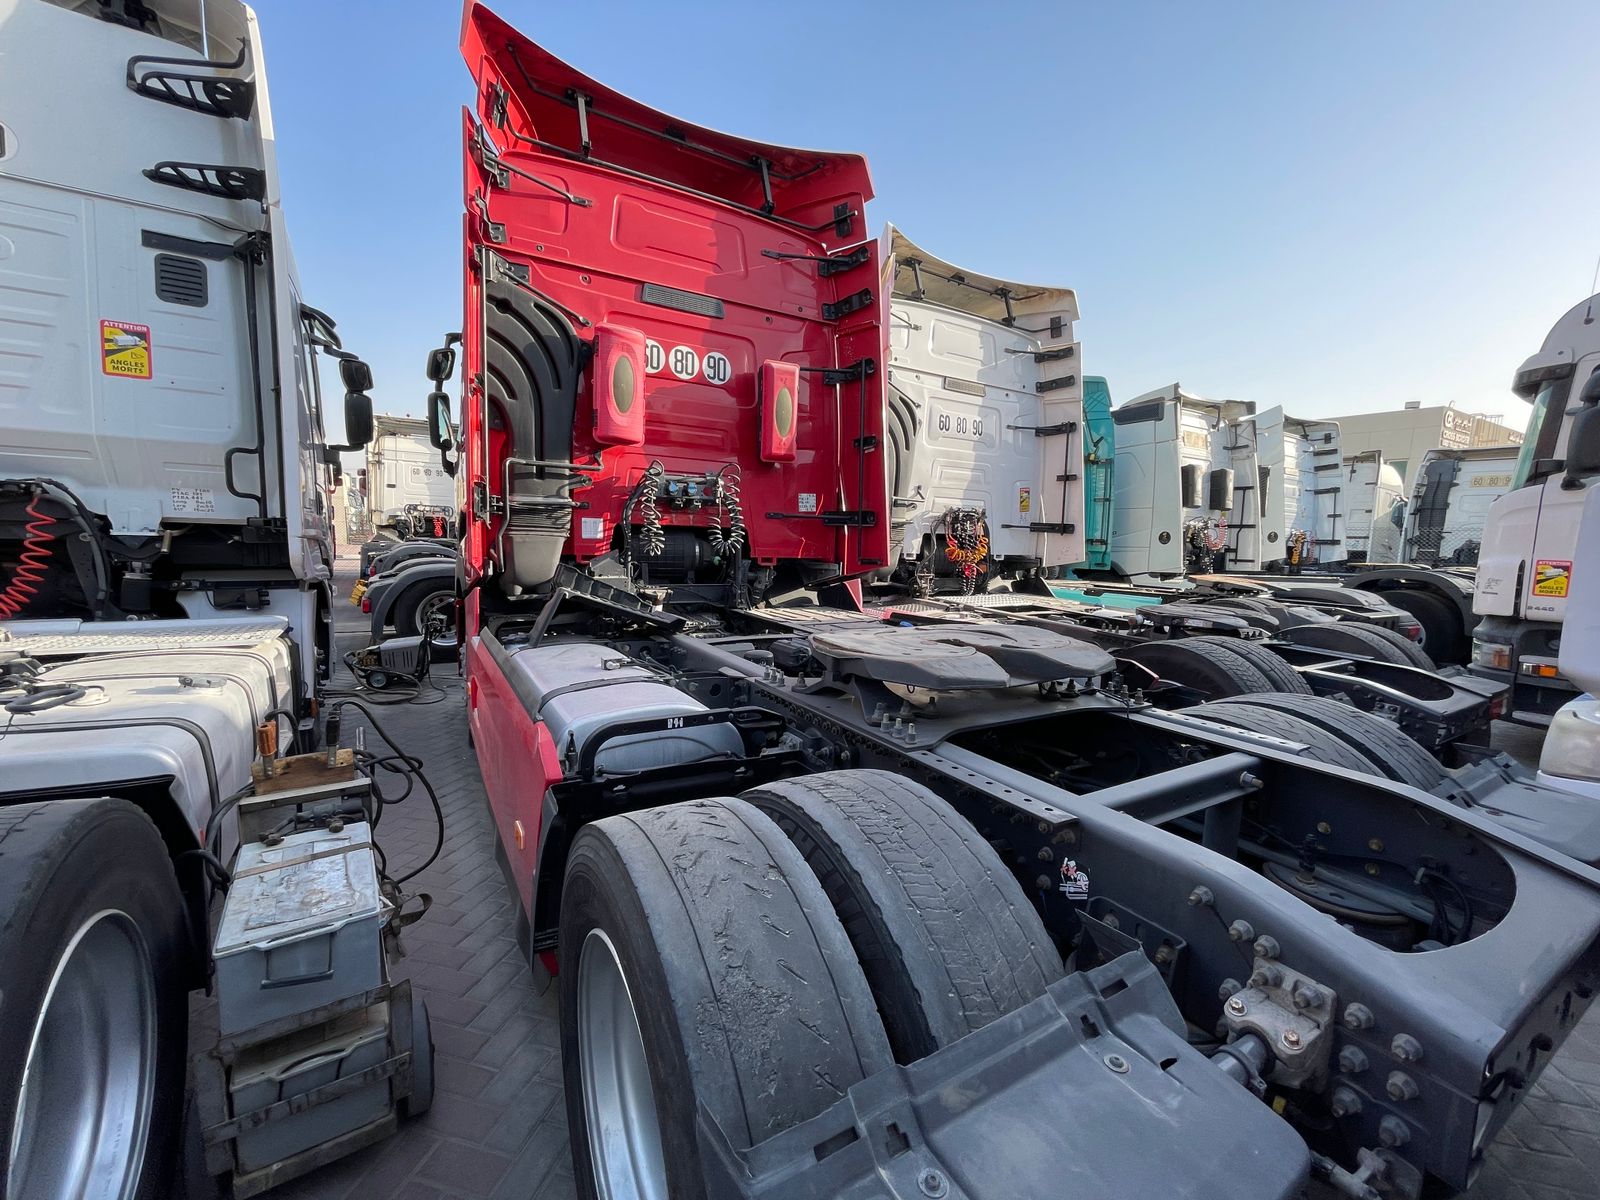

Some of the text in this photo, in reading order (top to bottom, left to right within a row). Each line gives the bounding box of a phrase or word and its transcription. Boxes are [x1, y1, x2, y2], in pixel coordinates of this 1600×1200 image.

[104, 321, 147, 331] ATTENTION
[110, 359, 145, 368] ANGLES
[674, 348, 695, 377] 80
[707, 355, 727, 382] 90
[112, 365, 144, 374] MORTS
[939, 414, 983, 436] 60 80 90
[1473, 477, 1483, 486] 60
[1488, 476, 1499, 486] 80
